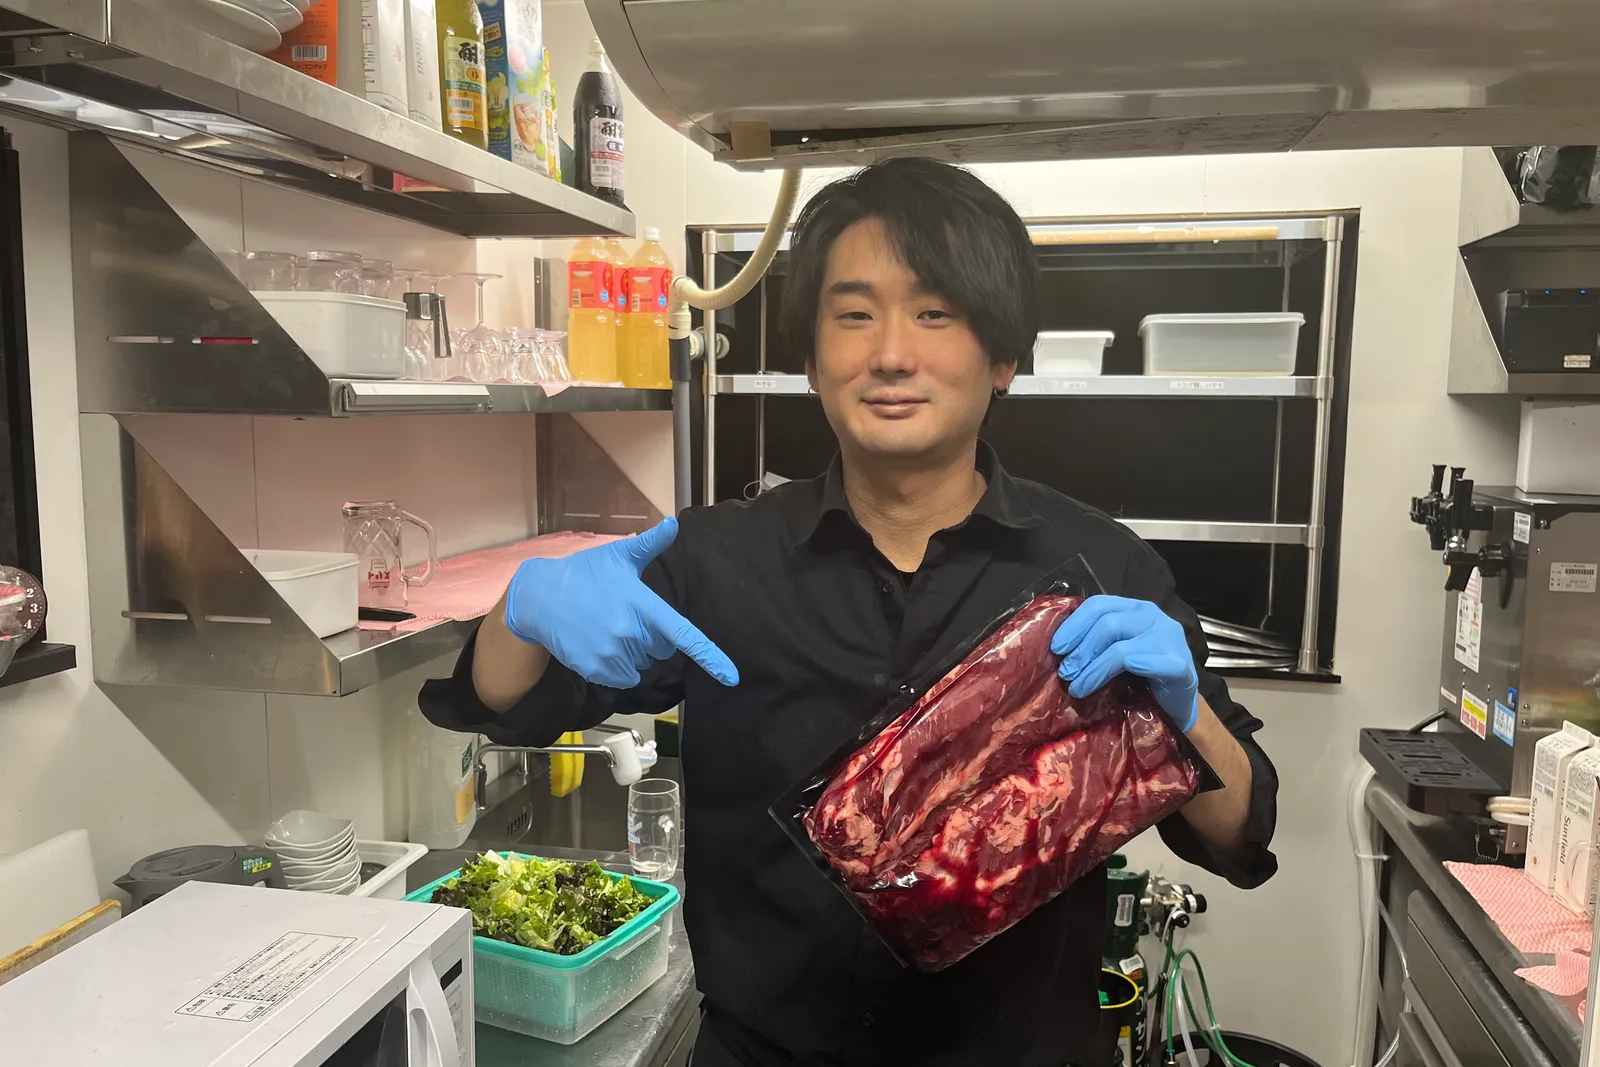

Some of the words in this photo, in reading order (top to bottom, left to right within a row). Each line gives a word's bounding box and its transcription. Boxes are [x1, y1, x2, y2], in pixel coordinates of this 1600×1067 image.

[26, 588, 34, 598] 2
[30, 603, 38, 613] 3
[24, 619, 32, 629] 4
[1528, 796, 1538, 843] Sunfield
[1559, 815, 1571, 865] Sunfield
